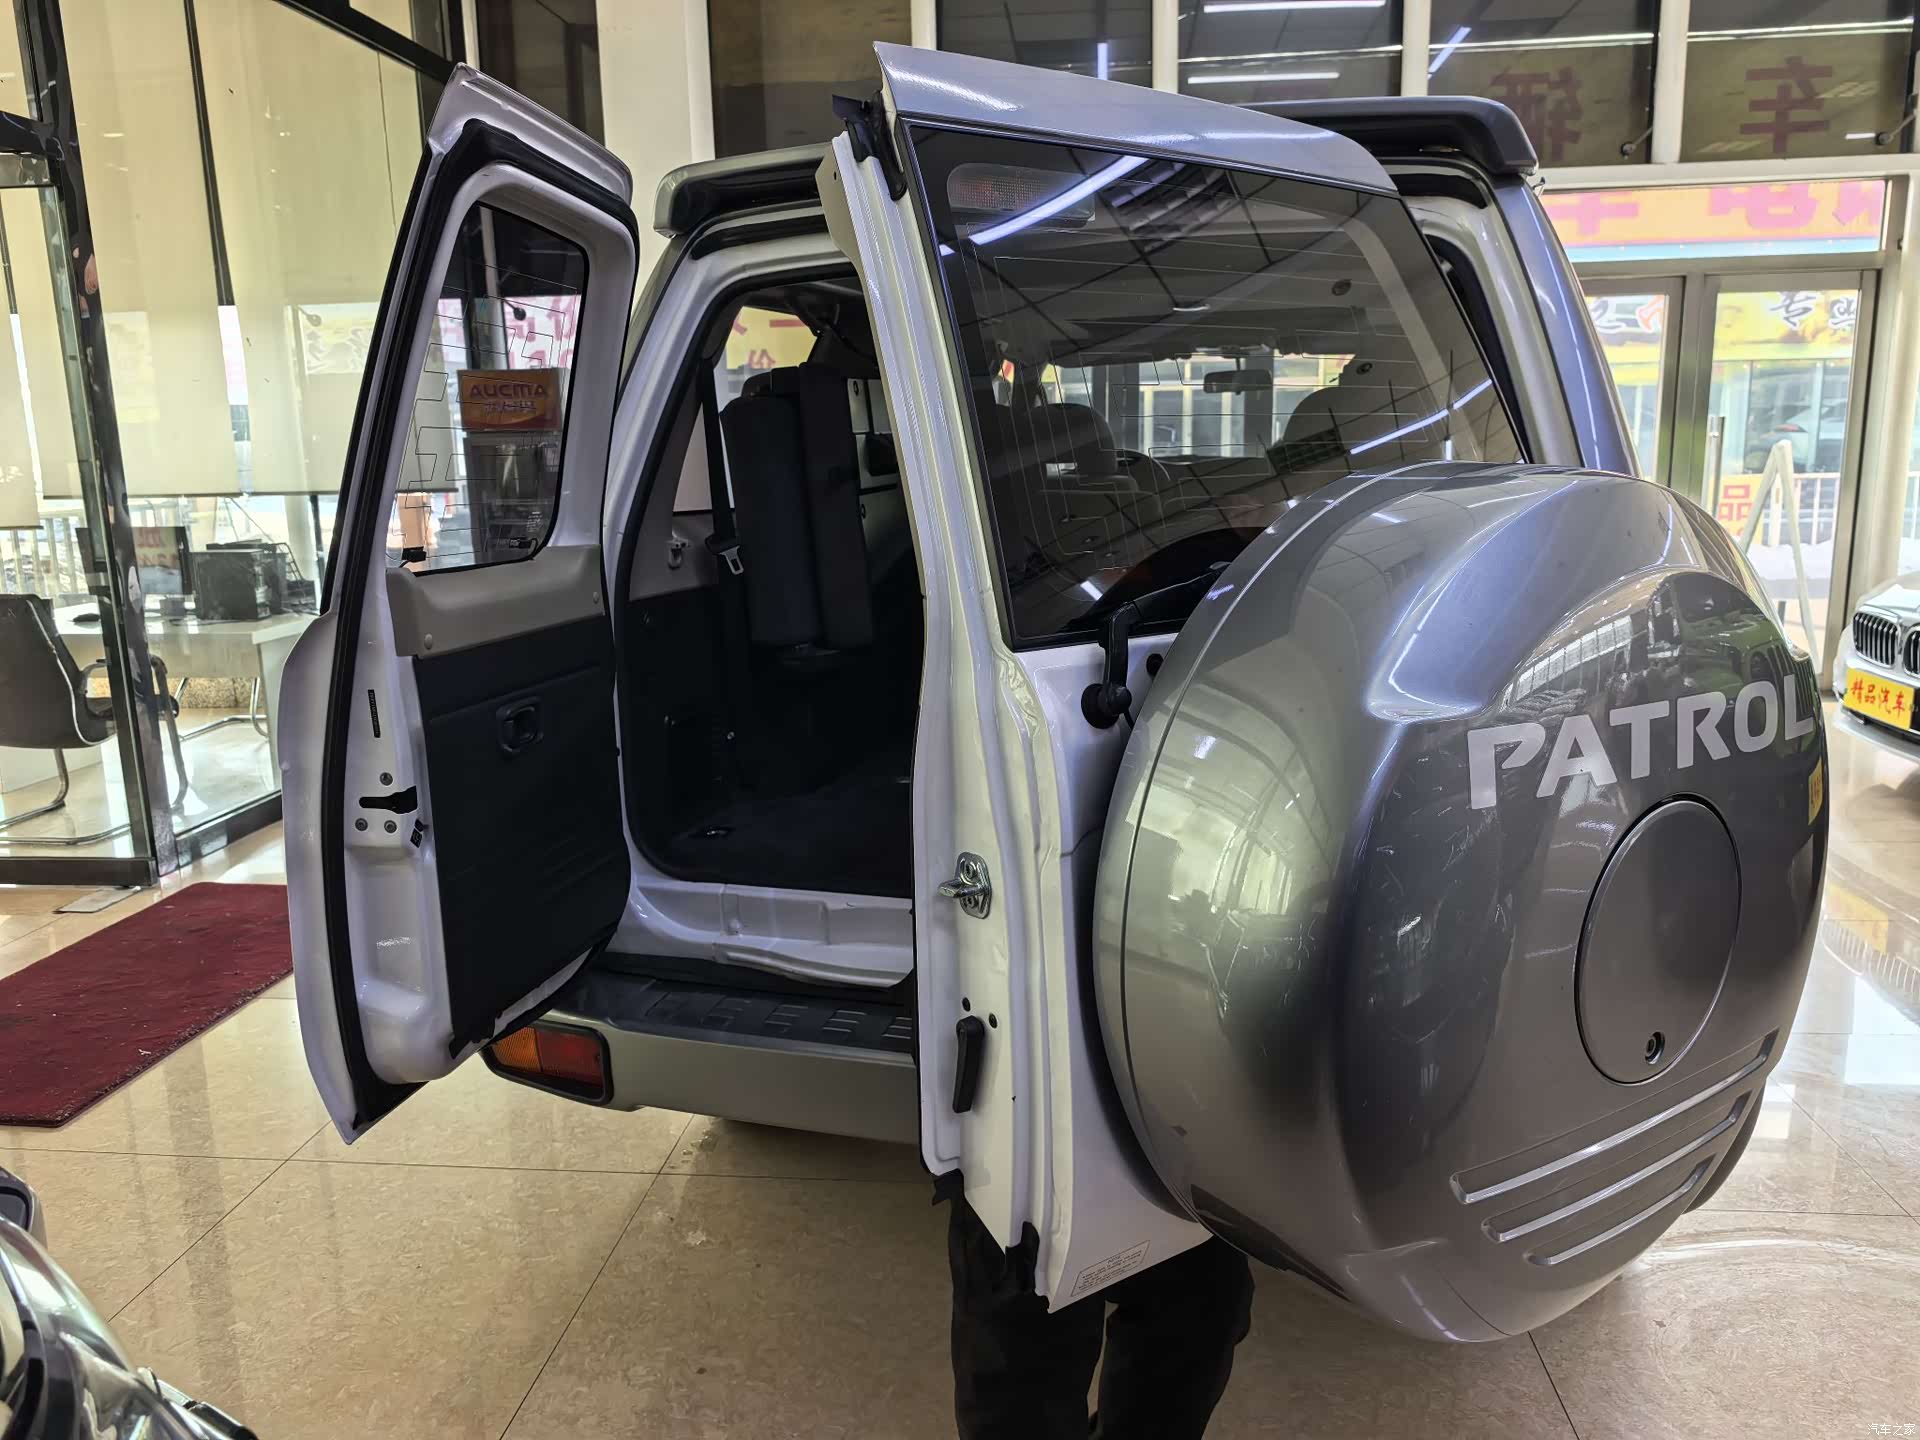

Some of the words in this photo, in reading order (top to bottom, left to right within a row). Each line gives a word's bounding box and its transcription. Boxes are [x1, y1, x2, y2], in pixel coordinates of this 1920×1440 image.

[470, 383, 547, 399] AUCMA
[1850, 676, 1905, 718] 精品汽车
[1467, 674, 1814, 810] PATROL
